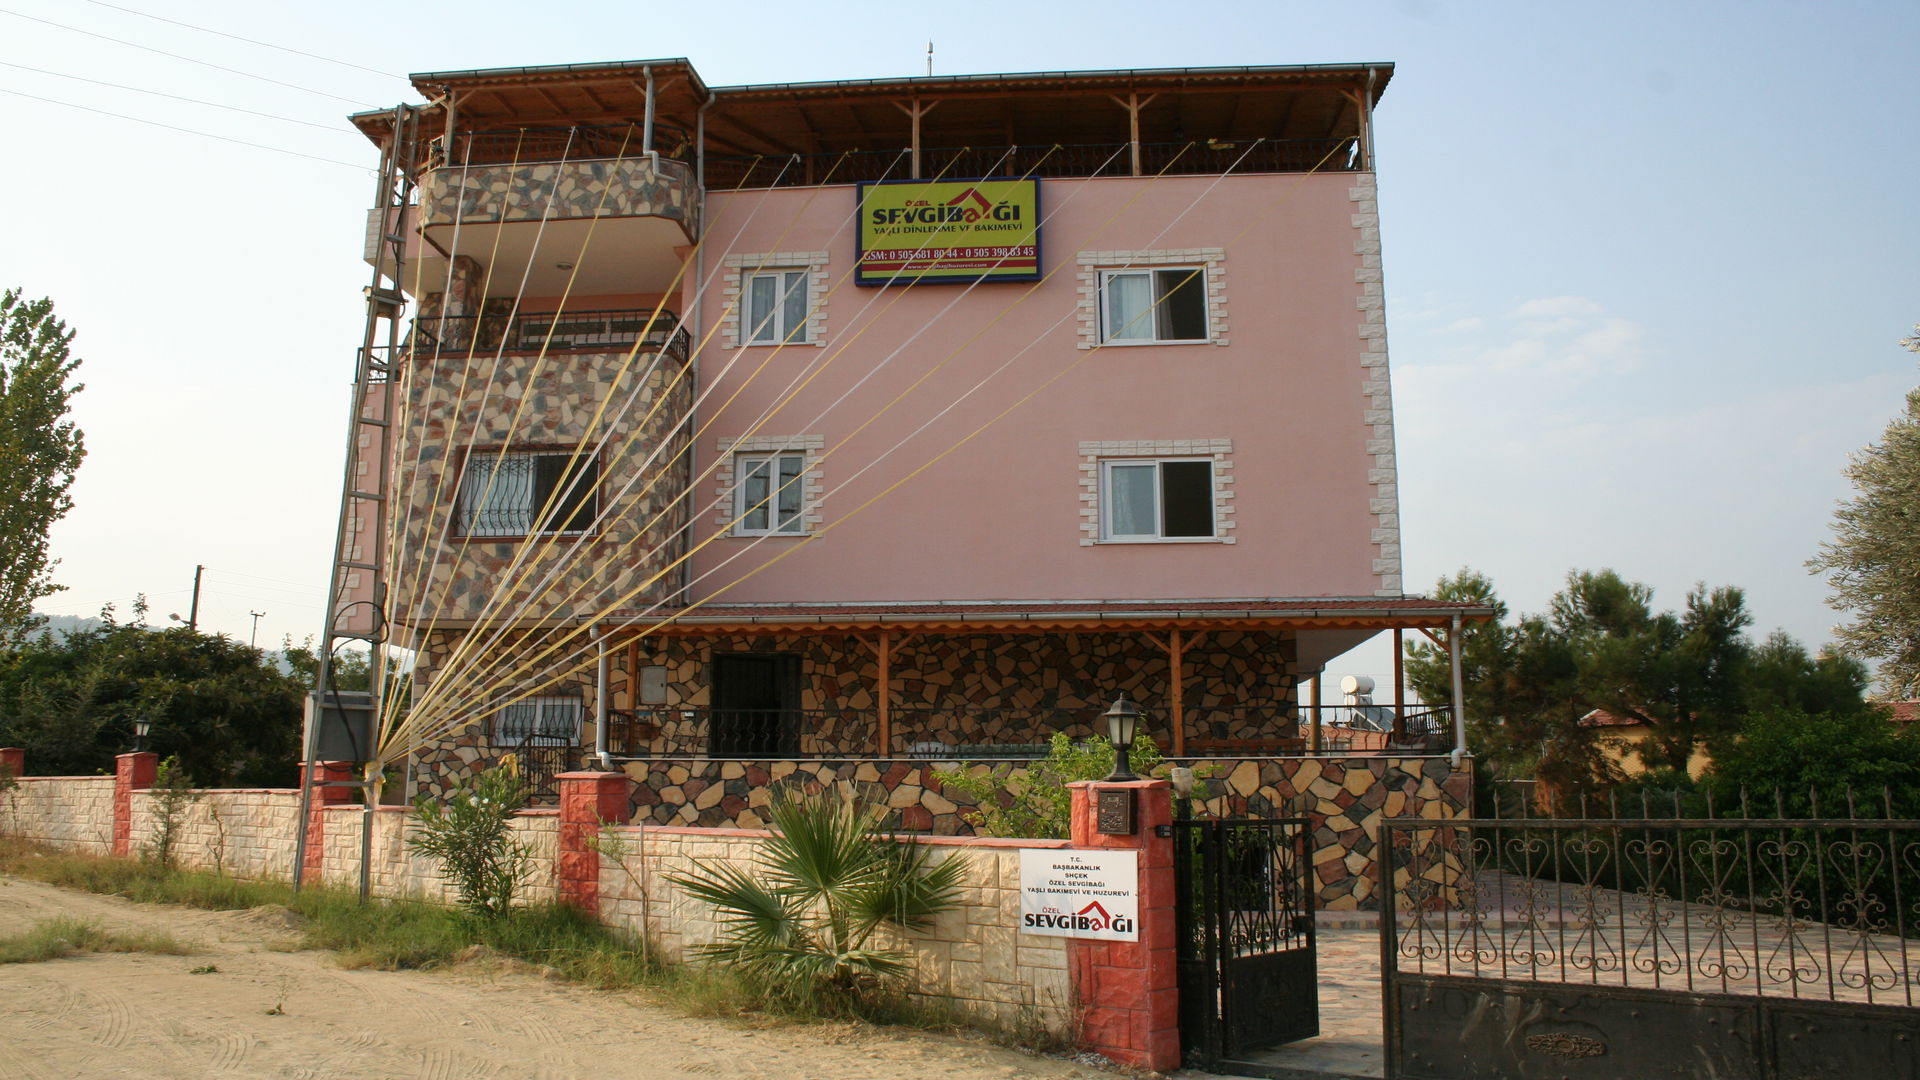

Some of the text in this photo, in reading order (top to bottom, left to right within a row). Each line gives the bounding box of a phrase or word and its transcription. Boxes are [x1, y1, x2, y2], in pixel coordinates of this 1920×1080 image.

[905, 199, 931, 207] ÖZEL
[874, 227, 900, 235] YAŞLI
[903, 225, 956, 234] DİNLENME
[974, 222, 1022, 232] BAKIMEVİ
[864, 250, 887, 261] GSM:
[889, 250, 896, 260] 0
[898, 250, 913, 260] 505
[915, 250, 930, 259] 681
[934, 249, 945, 259] 80
[947, 248, 957, 258] 44
[965, 248, 971, 257] 0
[973, 248, 989, 257] 505
[991, 247, 1007, 257] 398
[1010, 247, 1021, 256] 83
[1023, 247, 1034, 256] 45
[1068, 880, 1105, 888] SEVGİBAĞI
[1047, 887, 1080, 895] BAKIMEVİ
[1093, 889, 1129, 897] HUZUREVİ
